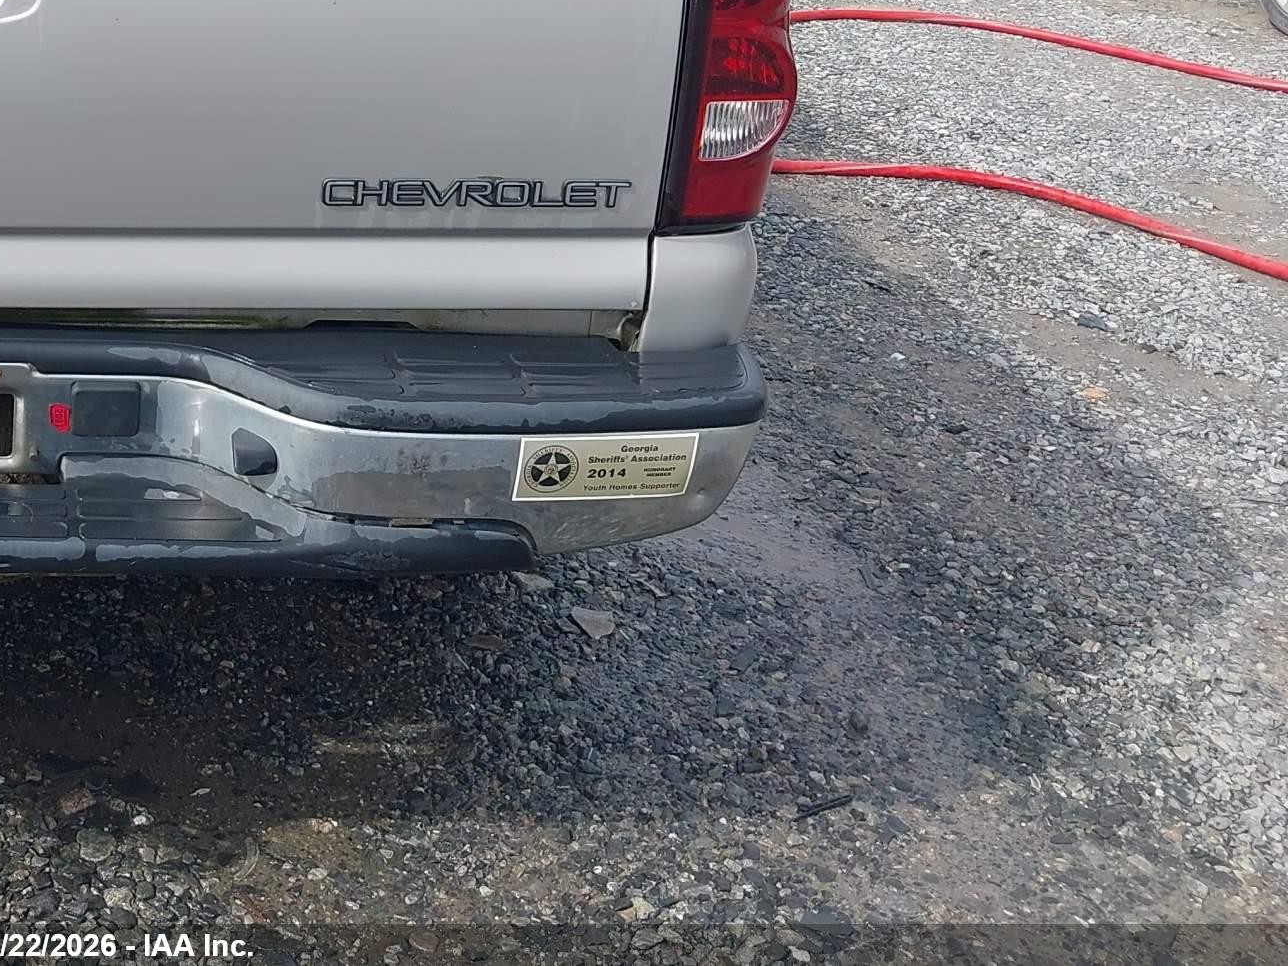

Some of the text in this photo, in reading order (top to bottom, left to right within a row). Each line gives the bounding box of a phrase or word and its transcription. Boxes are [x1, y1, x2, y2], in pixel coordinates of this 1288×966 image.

[322, 178, 632, 208] CHEVROLET
[620, 444, 659, 453] Georgia
[587, 454, 687, 464] Sheriffs' Association
[587, 468, 626, 478] 2014
[583, 484, 607, 492] Youth
[639, 482, 681, 491] Supporter
